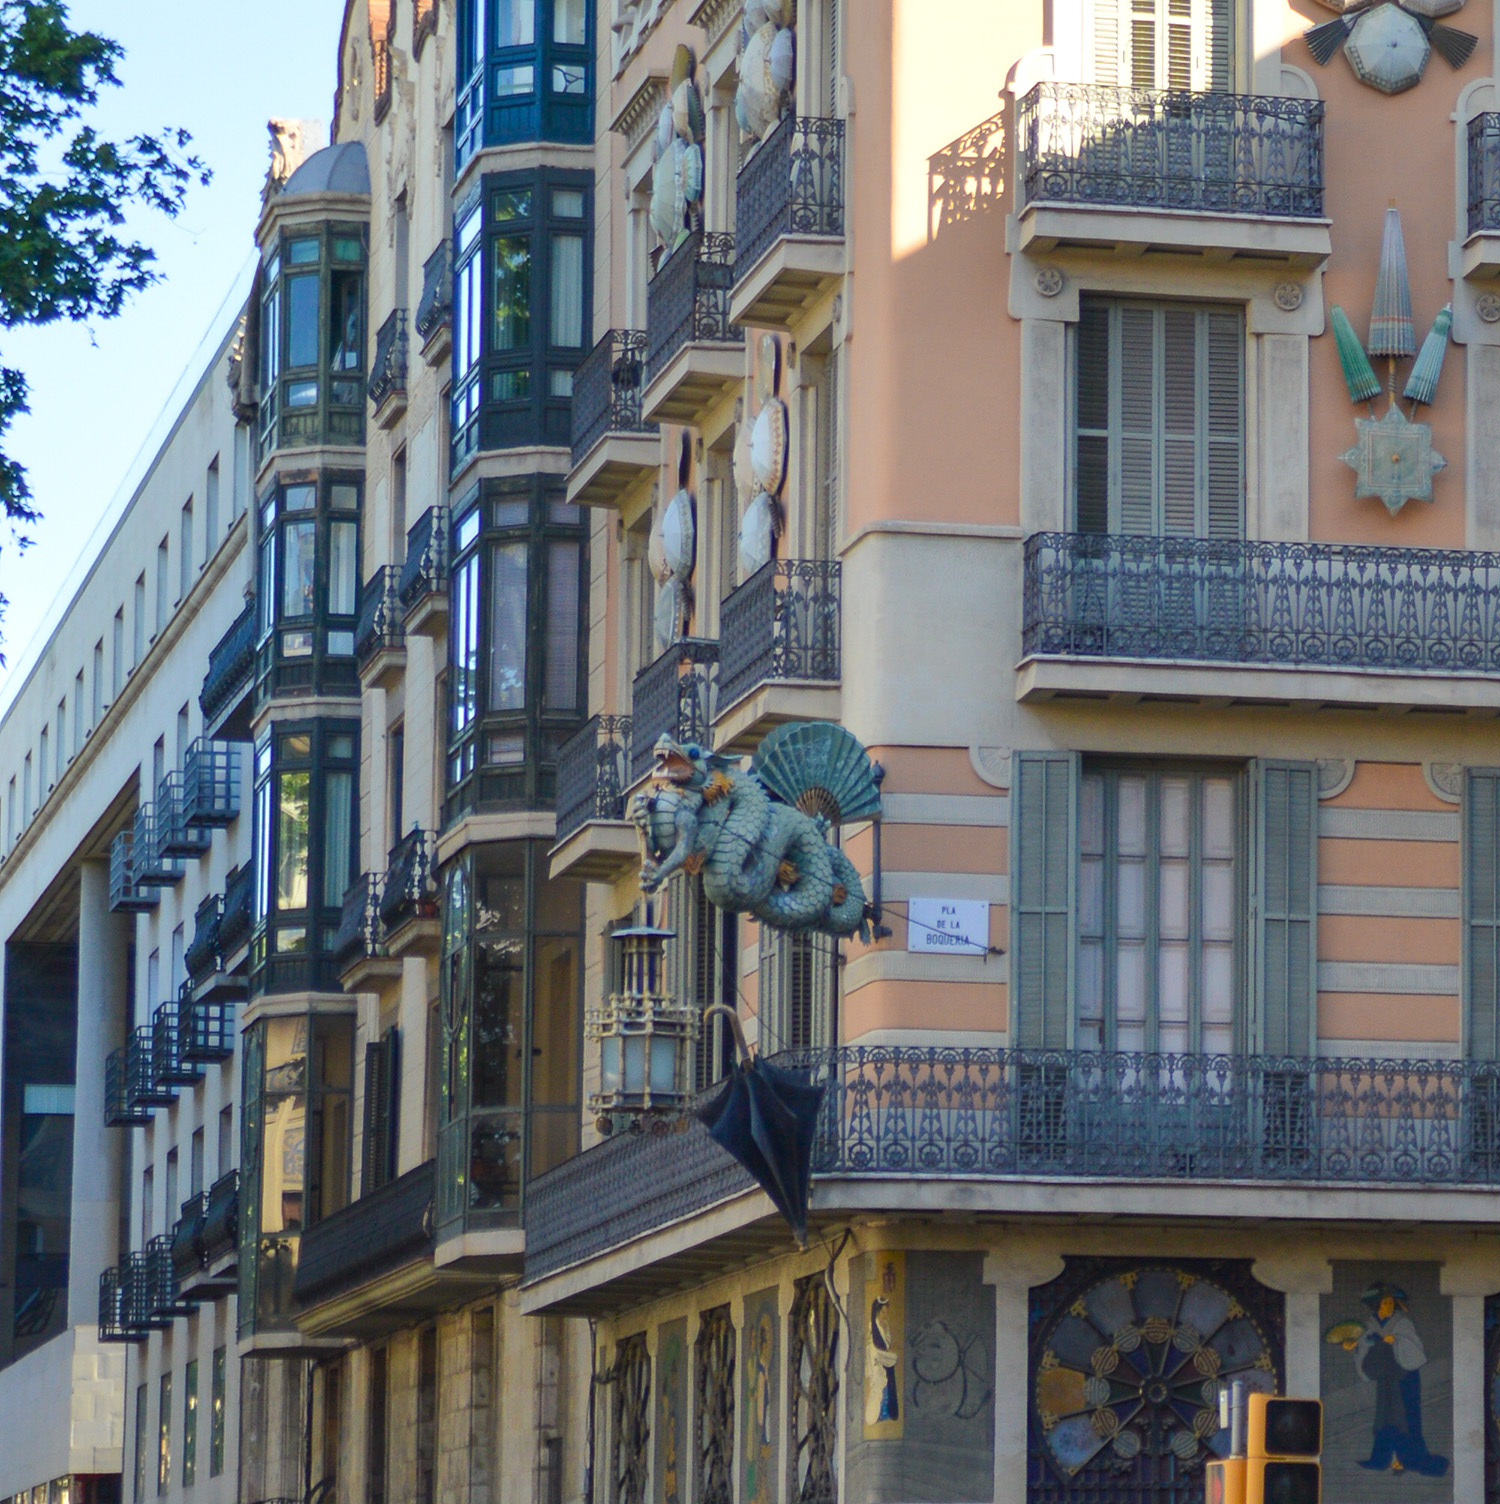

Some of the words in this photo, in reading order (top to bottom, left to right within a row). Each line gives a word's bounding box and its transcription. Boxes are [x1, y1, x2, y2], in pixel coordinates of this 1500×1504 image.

[941, 906, 956, 915] PLA
[937, 920, 947, 929] DE
[950, 920, 960, 929] LA
[926, 933, 970, 946] BOQUERIA
